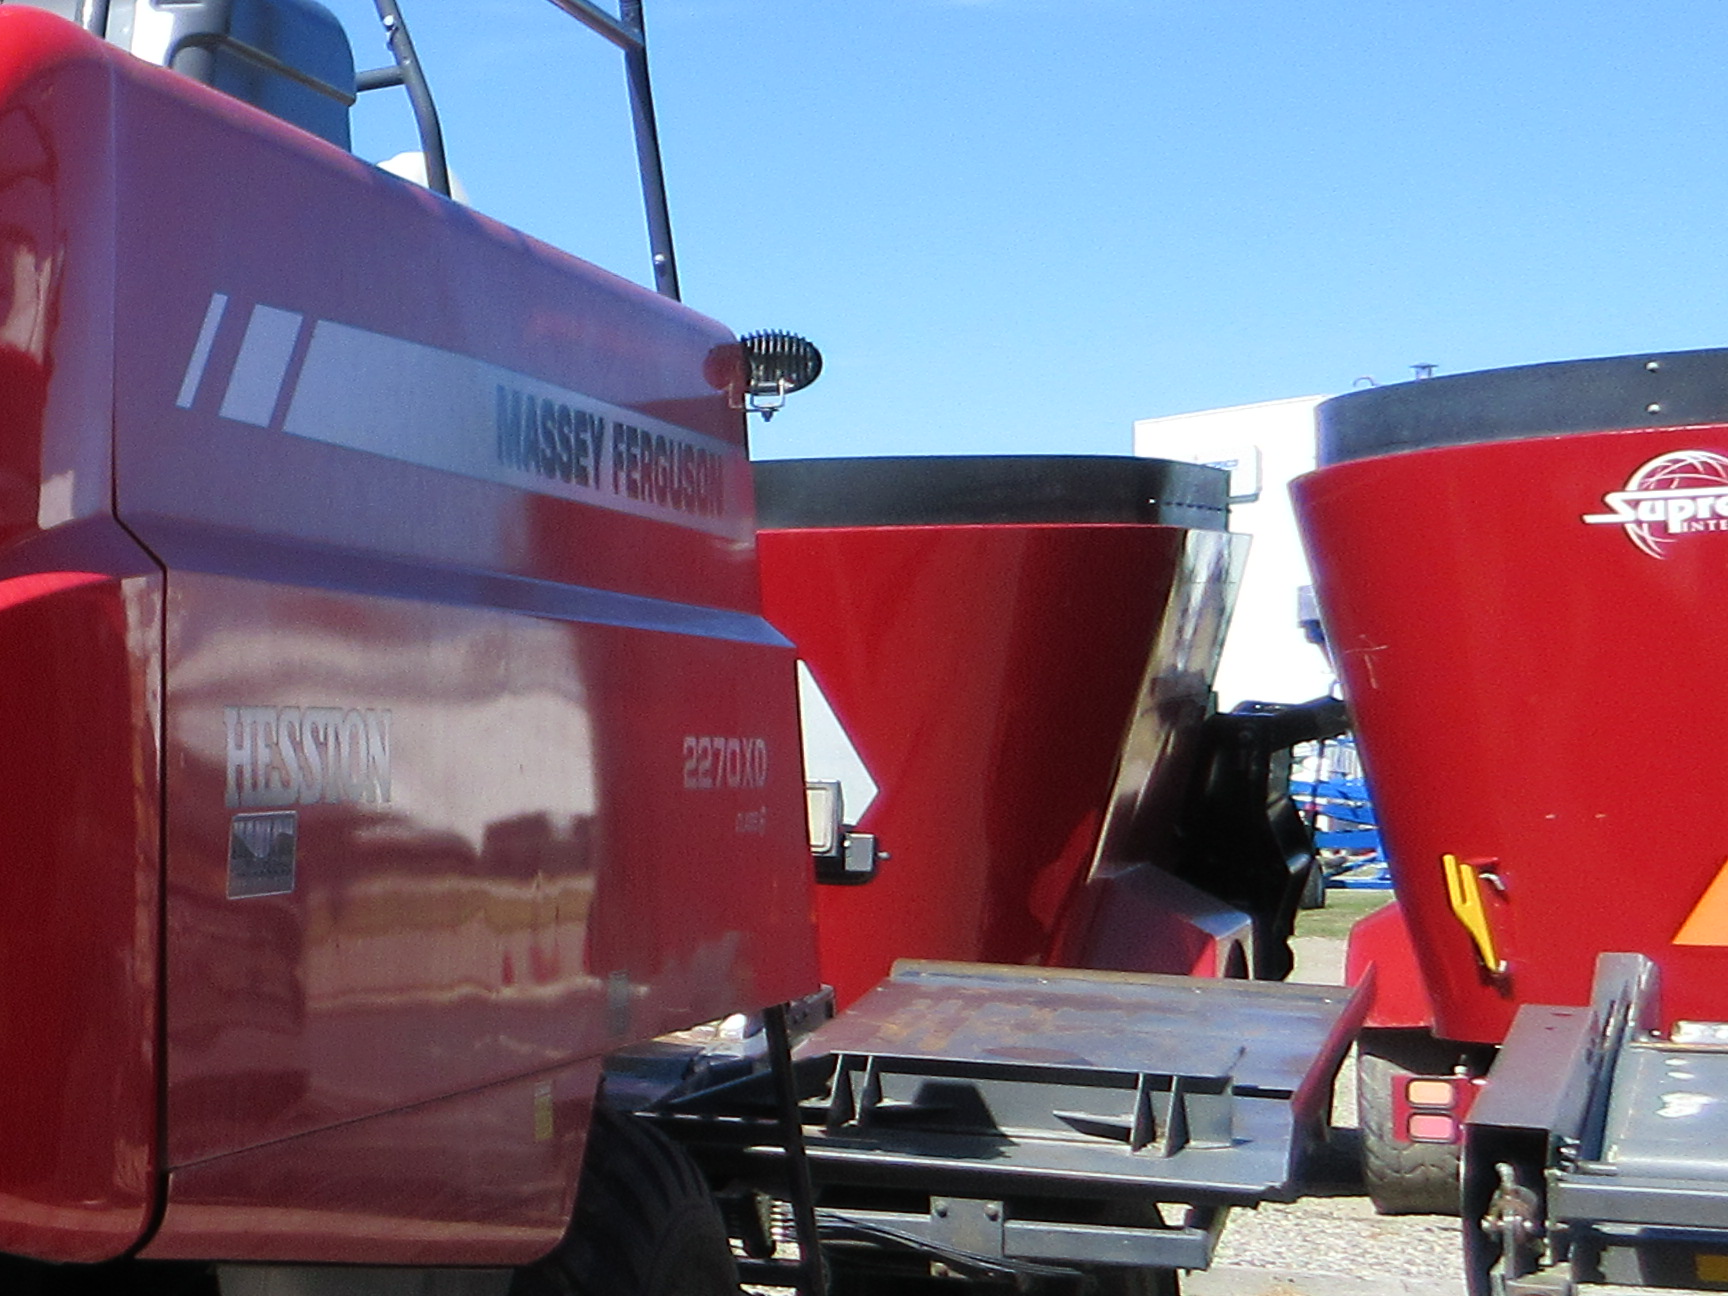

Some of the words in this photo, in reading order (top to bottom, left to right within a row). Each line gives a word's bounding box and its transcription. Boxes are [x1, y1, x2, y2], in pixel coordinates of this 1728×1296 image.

[496, 384, 604, 490] MASSEY
[612, 422, 725, 517] FERGUSON
[223, 705, 393, 808] HESSTON
[683, 736, 768, 789] 2270XD
